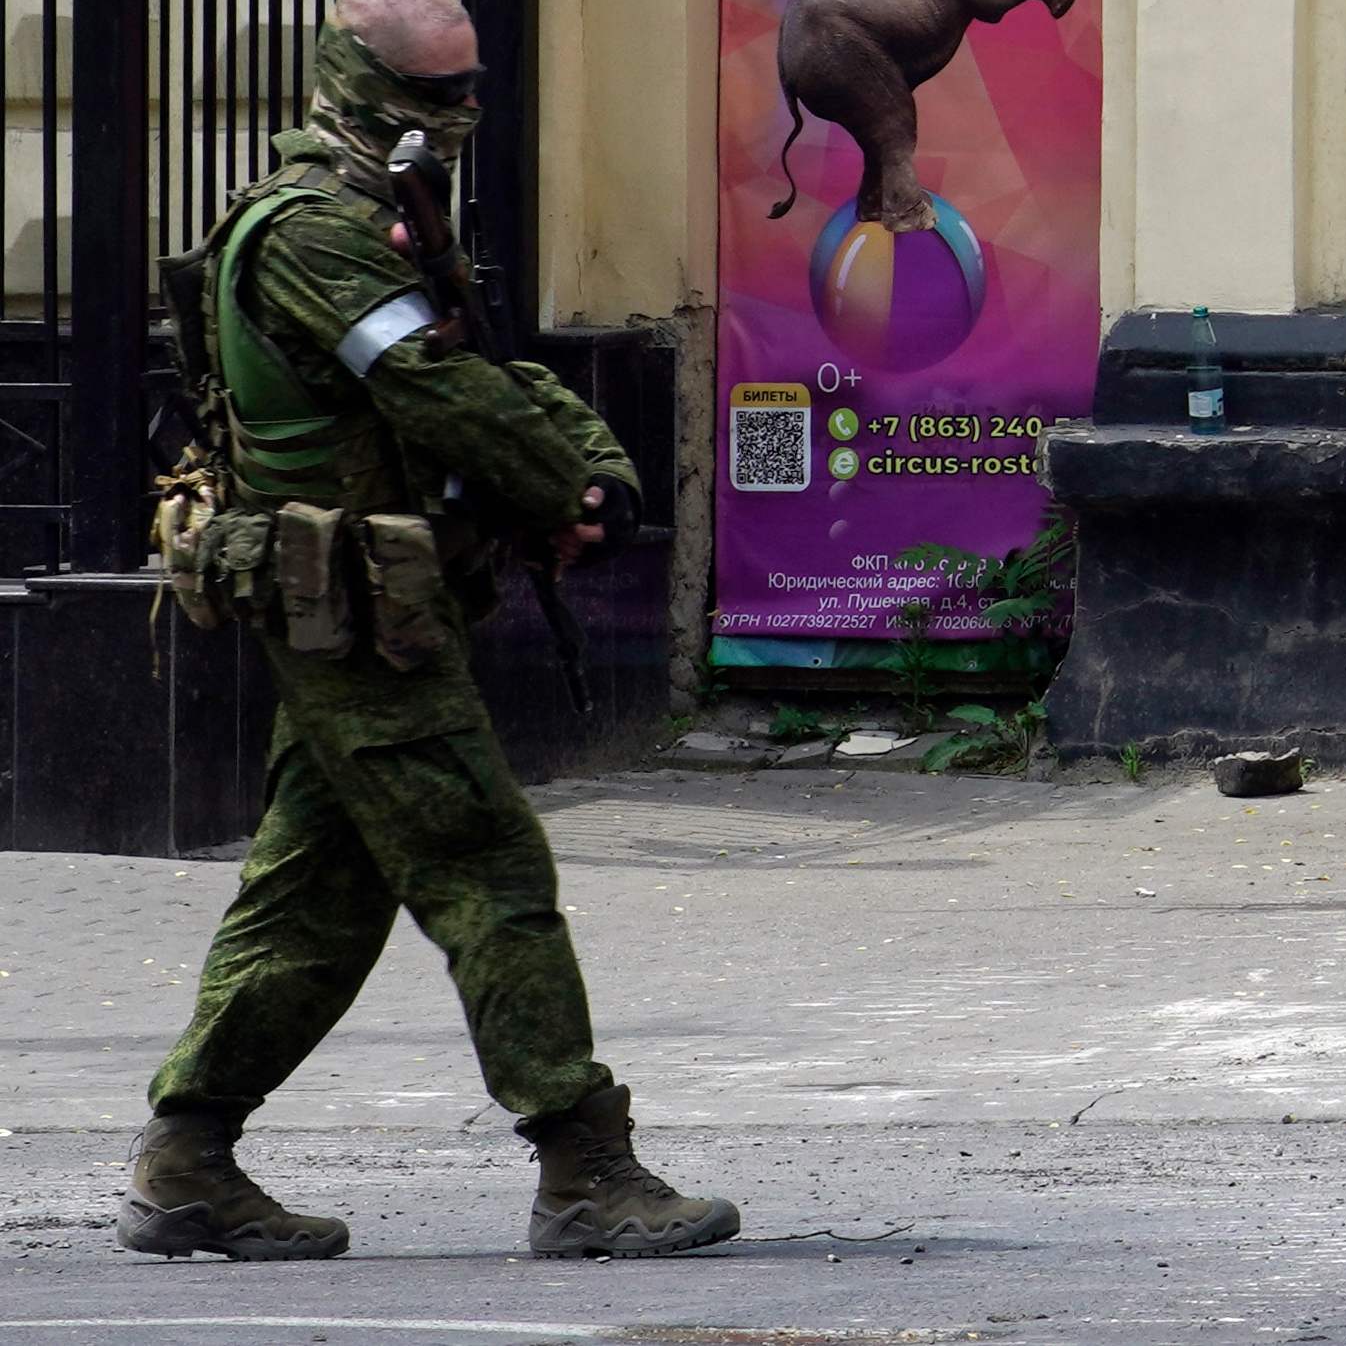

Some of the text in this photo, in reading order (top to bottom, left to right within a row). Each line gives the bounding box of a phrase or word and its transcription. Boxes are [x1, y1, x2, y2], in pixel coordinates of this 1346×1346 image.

[817, 362, 863, 394] 0+
[743, 390, 797, 402] БИЛЕТЫ
[868, 417, 899, 437] +7
[909, 416, 981, 442] (863)
[851, 554, 889, 571] ФКП
[768, 572, 883, 592] Юридический
[887, 576, 940, 592] адрес:
[818, 596, 841, 612] ул.
[766, 614, 877, 629] 1027739272527
